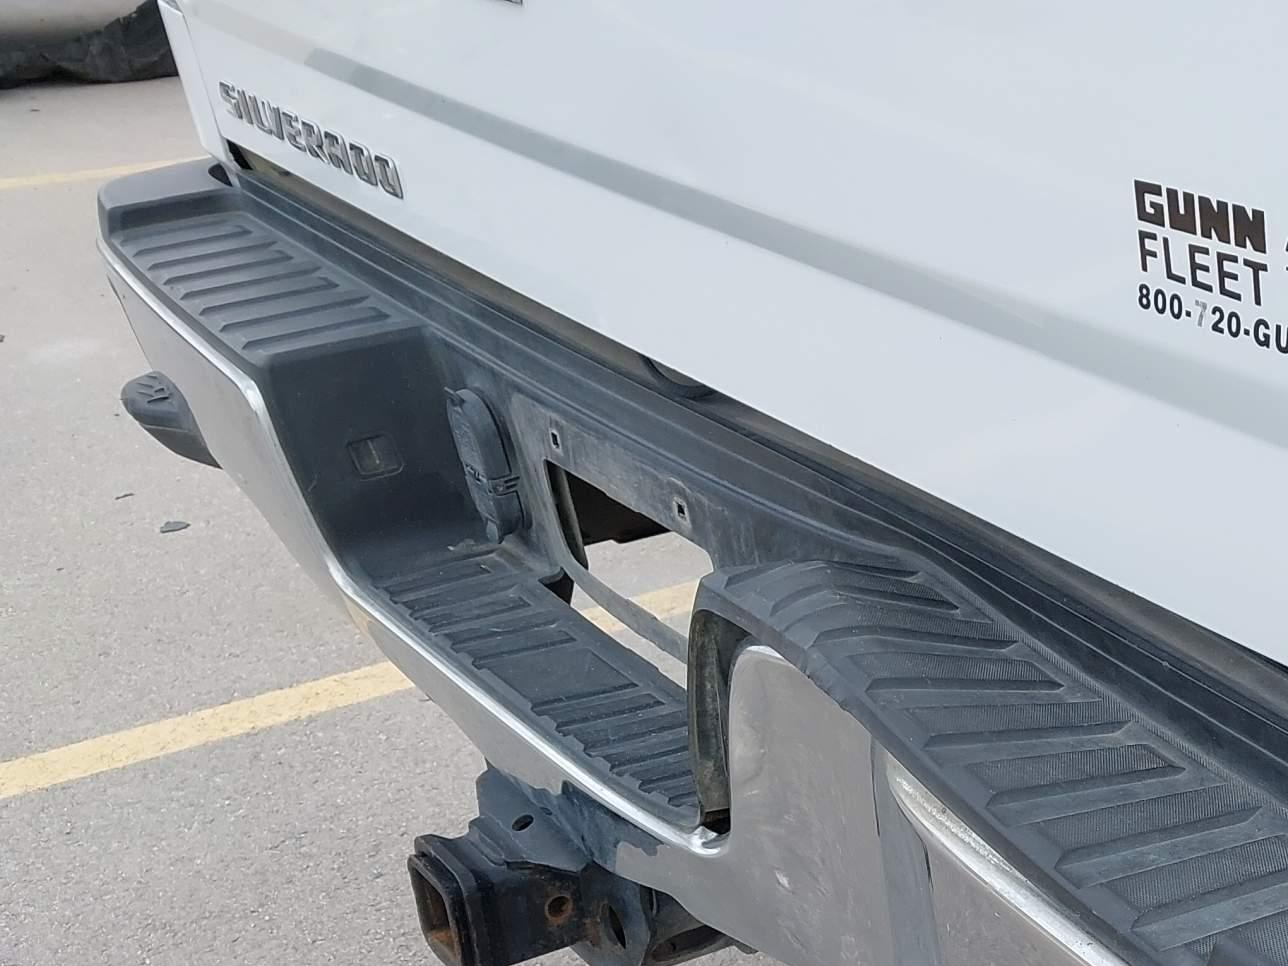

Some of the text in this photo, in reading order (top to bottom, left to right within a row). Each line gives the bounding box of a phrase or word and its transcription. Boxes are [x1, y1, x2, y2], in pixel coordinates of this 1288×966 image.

[218, 80, 405, 200] SILVERADO
[1133, 178, 1267, 254] GUNN
[1137, 229, 1269, 306] FLEET
